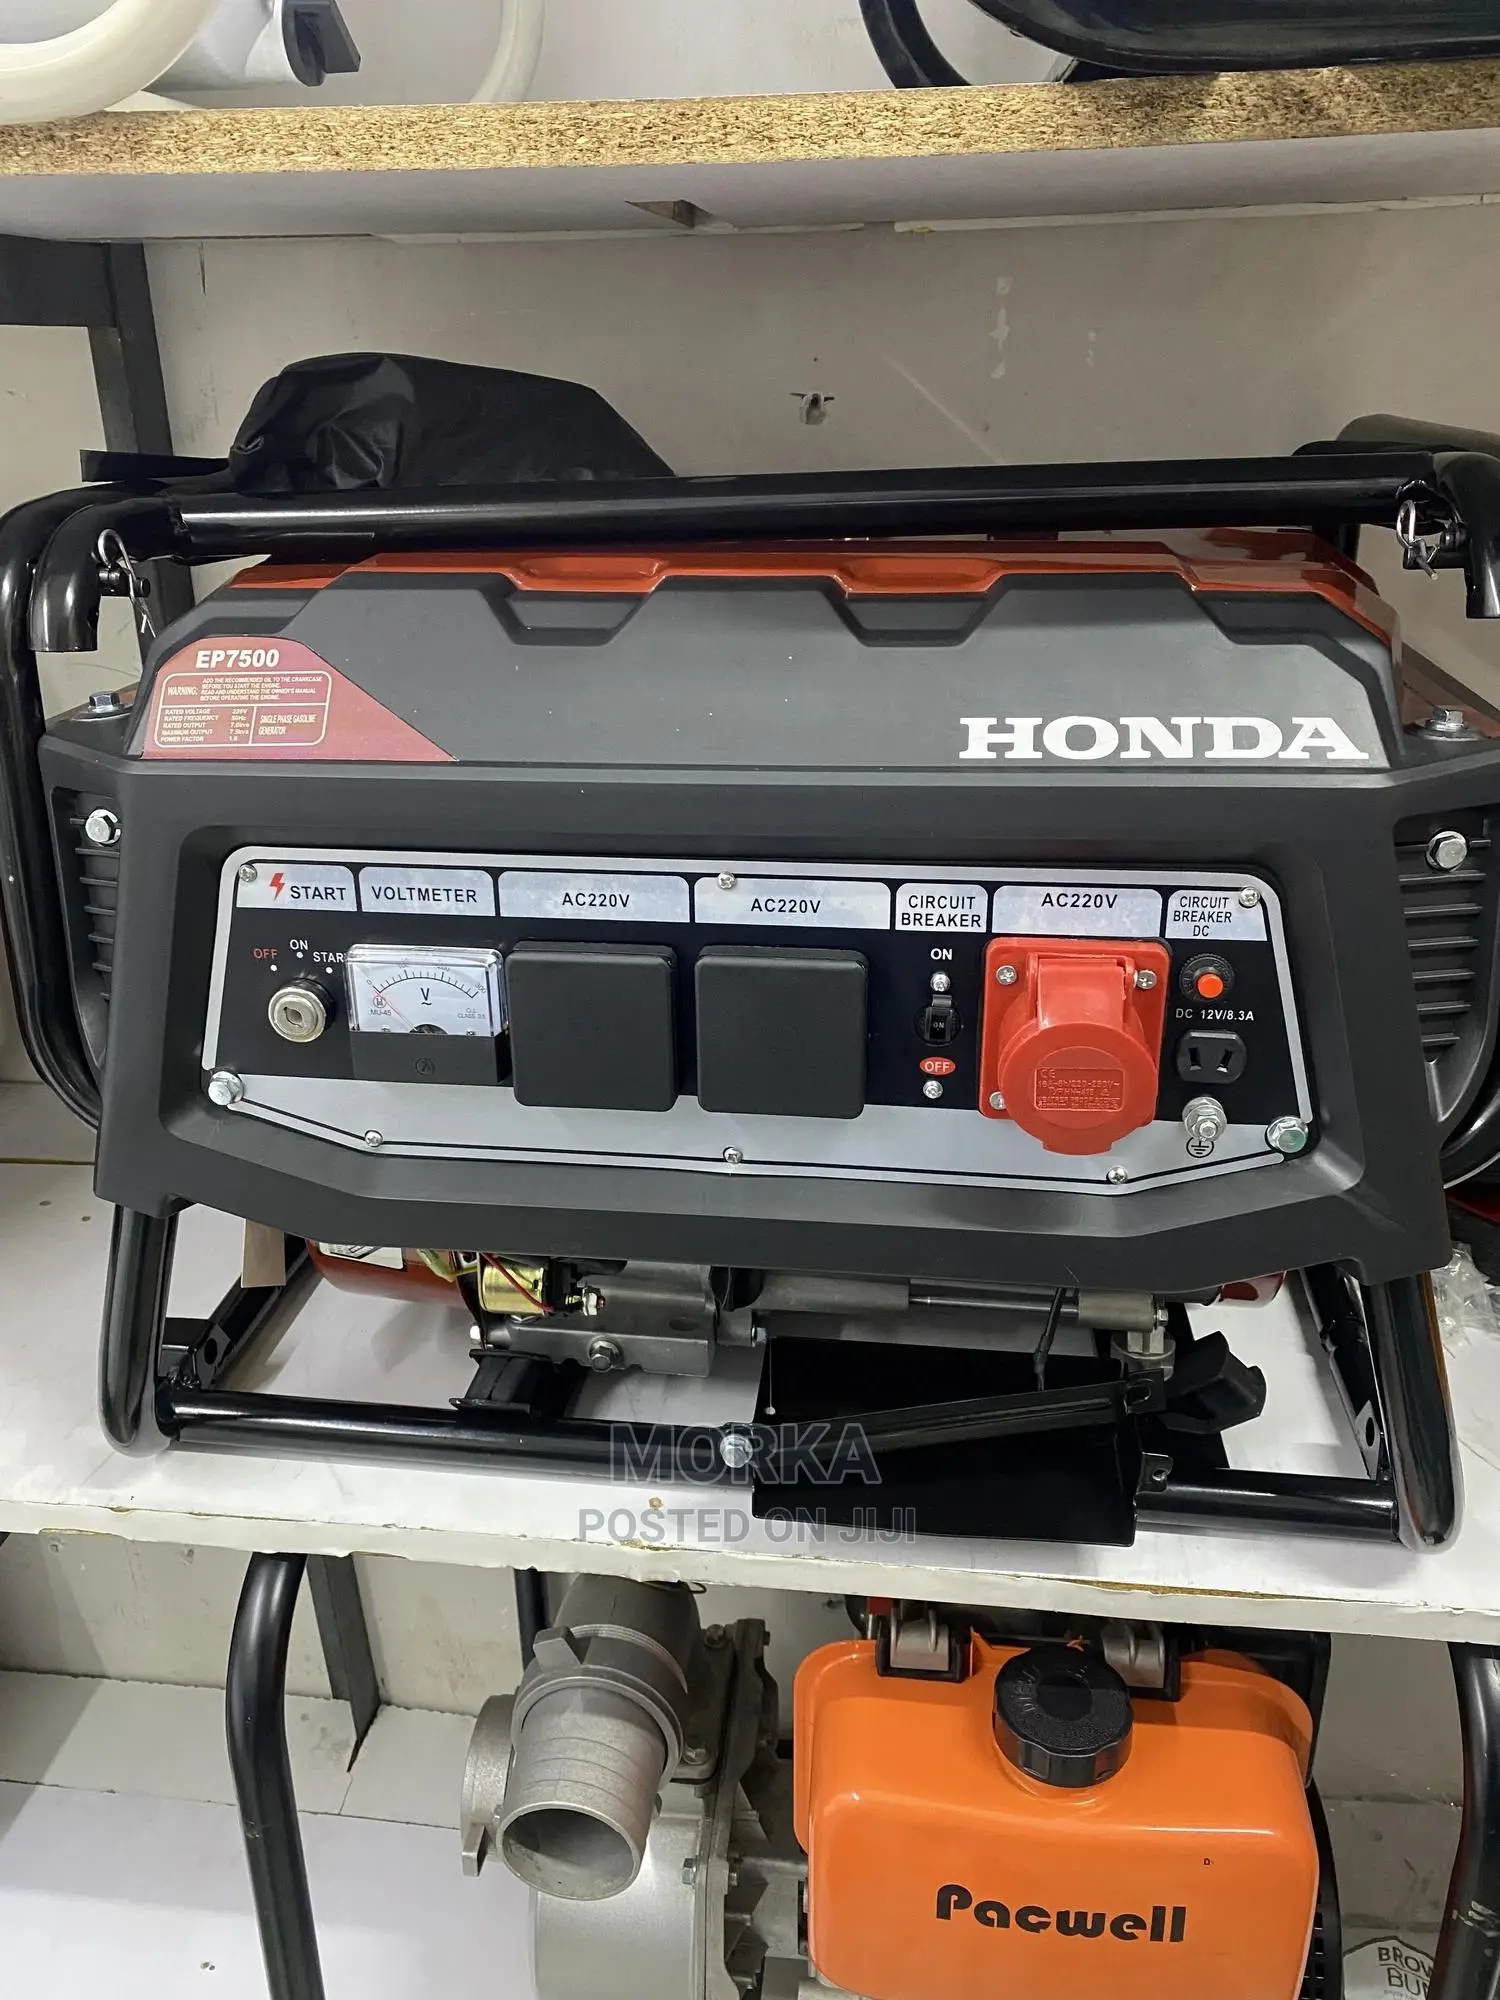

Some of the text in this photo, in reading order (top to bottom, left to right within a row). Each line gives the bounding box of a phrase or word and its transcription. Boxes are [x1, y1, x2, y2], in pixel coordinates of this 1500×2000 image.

[196, 649, 280, 668] EP7500
[958, 715, 1370, 760] HONDA
[290, 885, 347, 901] START
[371, 885, 478, 903] VOLTMETER
[561, 891, 630, 909] AC220V
[1041, 892, 1118, 909] AC220V
[750, 897, 822, 915] AC220V
[908, 894, 976, 911] CIRCUIT
[1180, 895, 1230, 910] CIRCUIT
[901, 912, 981, 929] BREAKER
[1173, 910, 1232, 924] BREAKER
[1192, 925, 1210, 937] DC
[290, 940, 308, 951] ON
[254, 948, 278, 960] OFF
[930, 948, 953, 961] ON
[1176, 1008, 1255, 1021] DC 12V/8.3A
[924, 1060, 950, 1073] OFF
[1040, 1069, 1056, 1078] CE
[936, 1883, 1187, 1944] Pacwell
